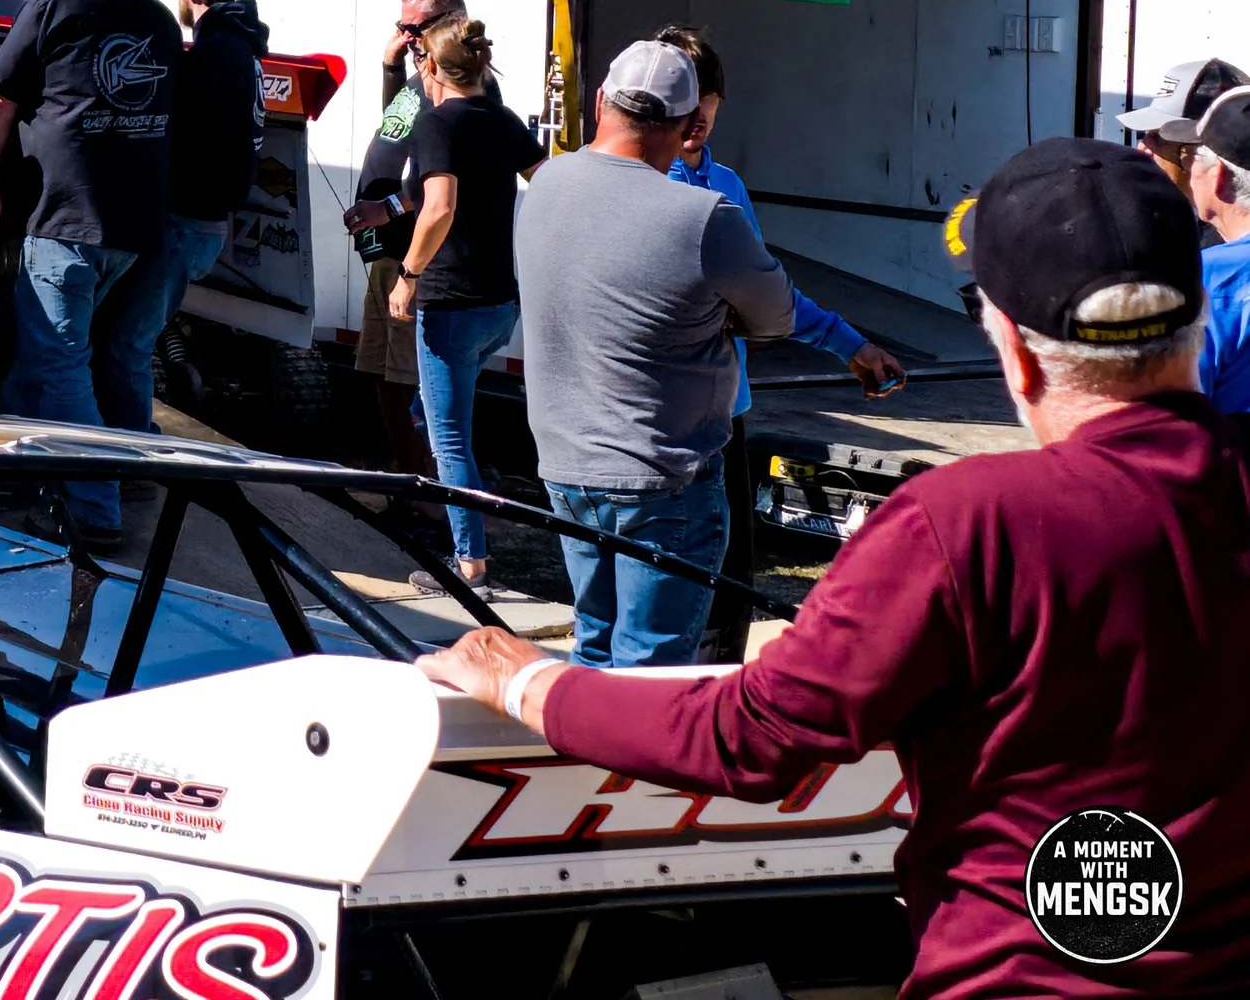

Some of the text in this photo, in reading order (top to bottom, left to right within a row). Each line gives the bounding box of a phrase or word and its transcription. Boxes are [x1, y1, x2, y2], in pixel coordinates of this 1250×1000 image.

[1076, 322, 1168, 342] VIETNAM VET
[83, 763, 228, 811] CRS
[123, 800, 171, 824] Racing
[174, 810, 225, 833] Supply
